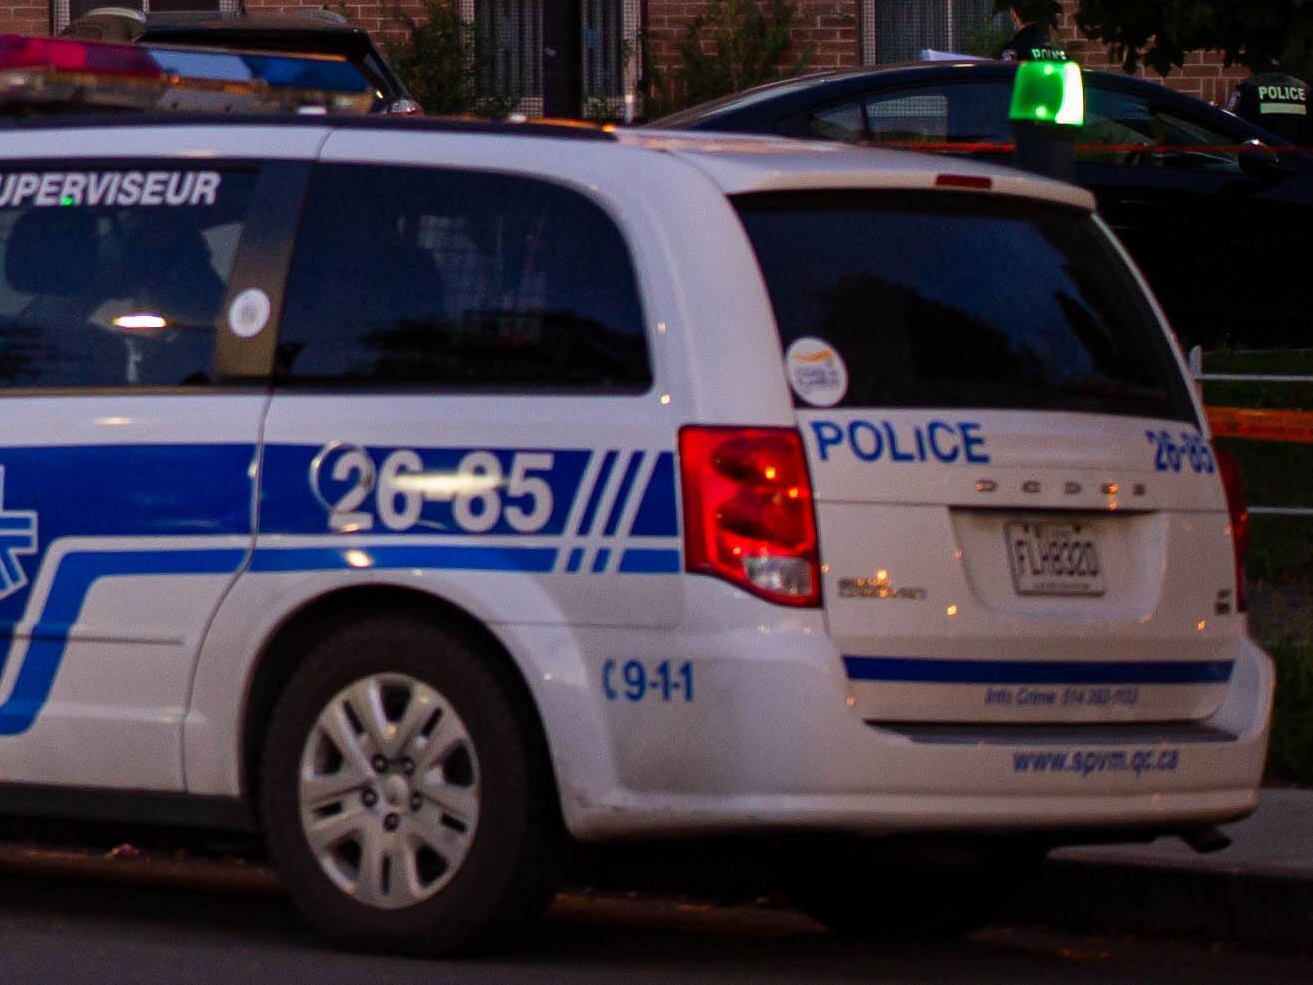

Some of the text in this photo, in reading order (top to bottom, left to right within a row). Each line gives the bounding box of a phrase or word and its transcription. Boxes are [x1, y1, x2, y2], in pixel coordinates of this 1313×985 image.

[1258, 85, 1307, 102] POLICE
[809, 419, 991, 464] POLICE
[327, 449, 555, 533] 26-85
[622, 659, 694, 702] 9-1-1
[1015, 686, 1056, 705] Crime
[1013, 749, 1180, 777] www.spvm.qc.ca
